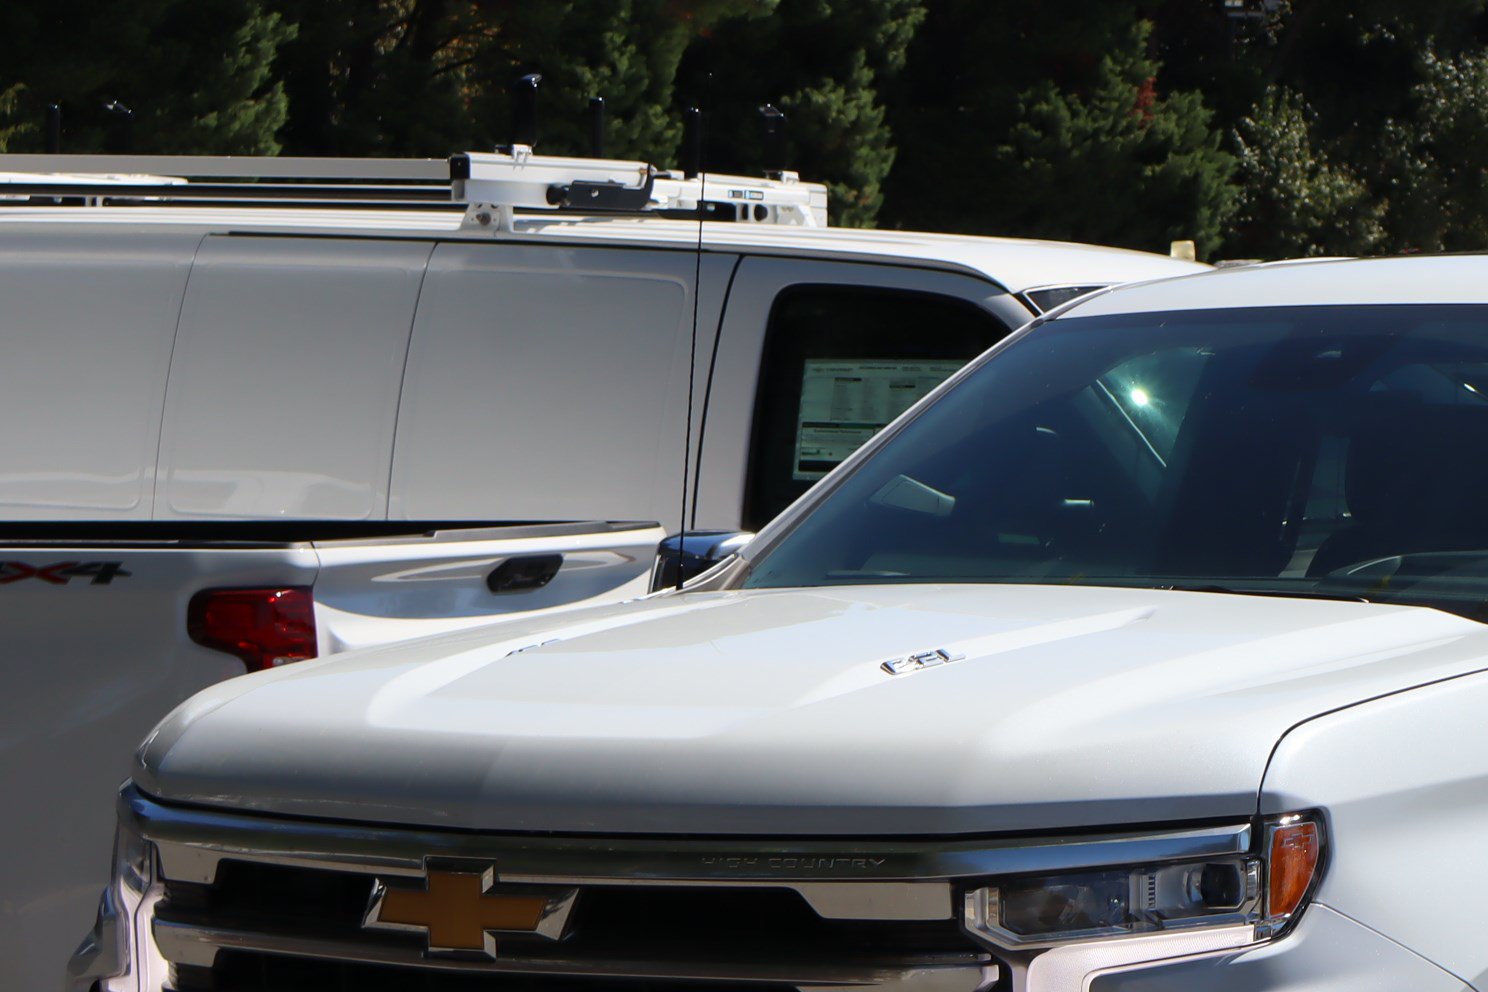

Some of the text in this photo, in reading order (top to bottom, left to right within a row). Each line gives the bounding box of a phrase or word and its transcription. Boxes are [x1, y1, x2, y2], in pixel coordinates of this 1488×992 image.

[0, 561, 132, 585] X4
[701, 857, 886, 868] HIGH COUNTRY
